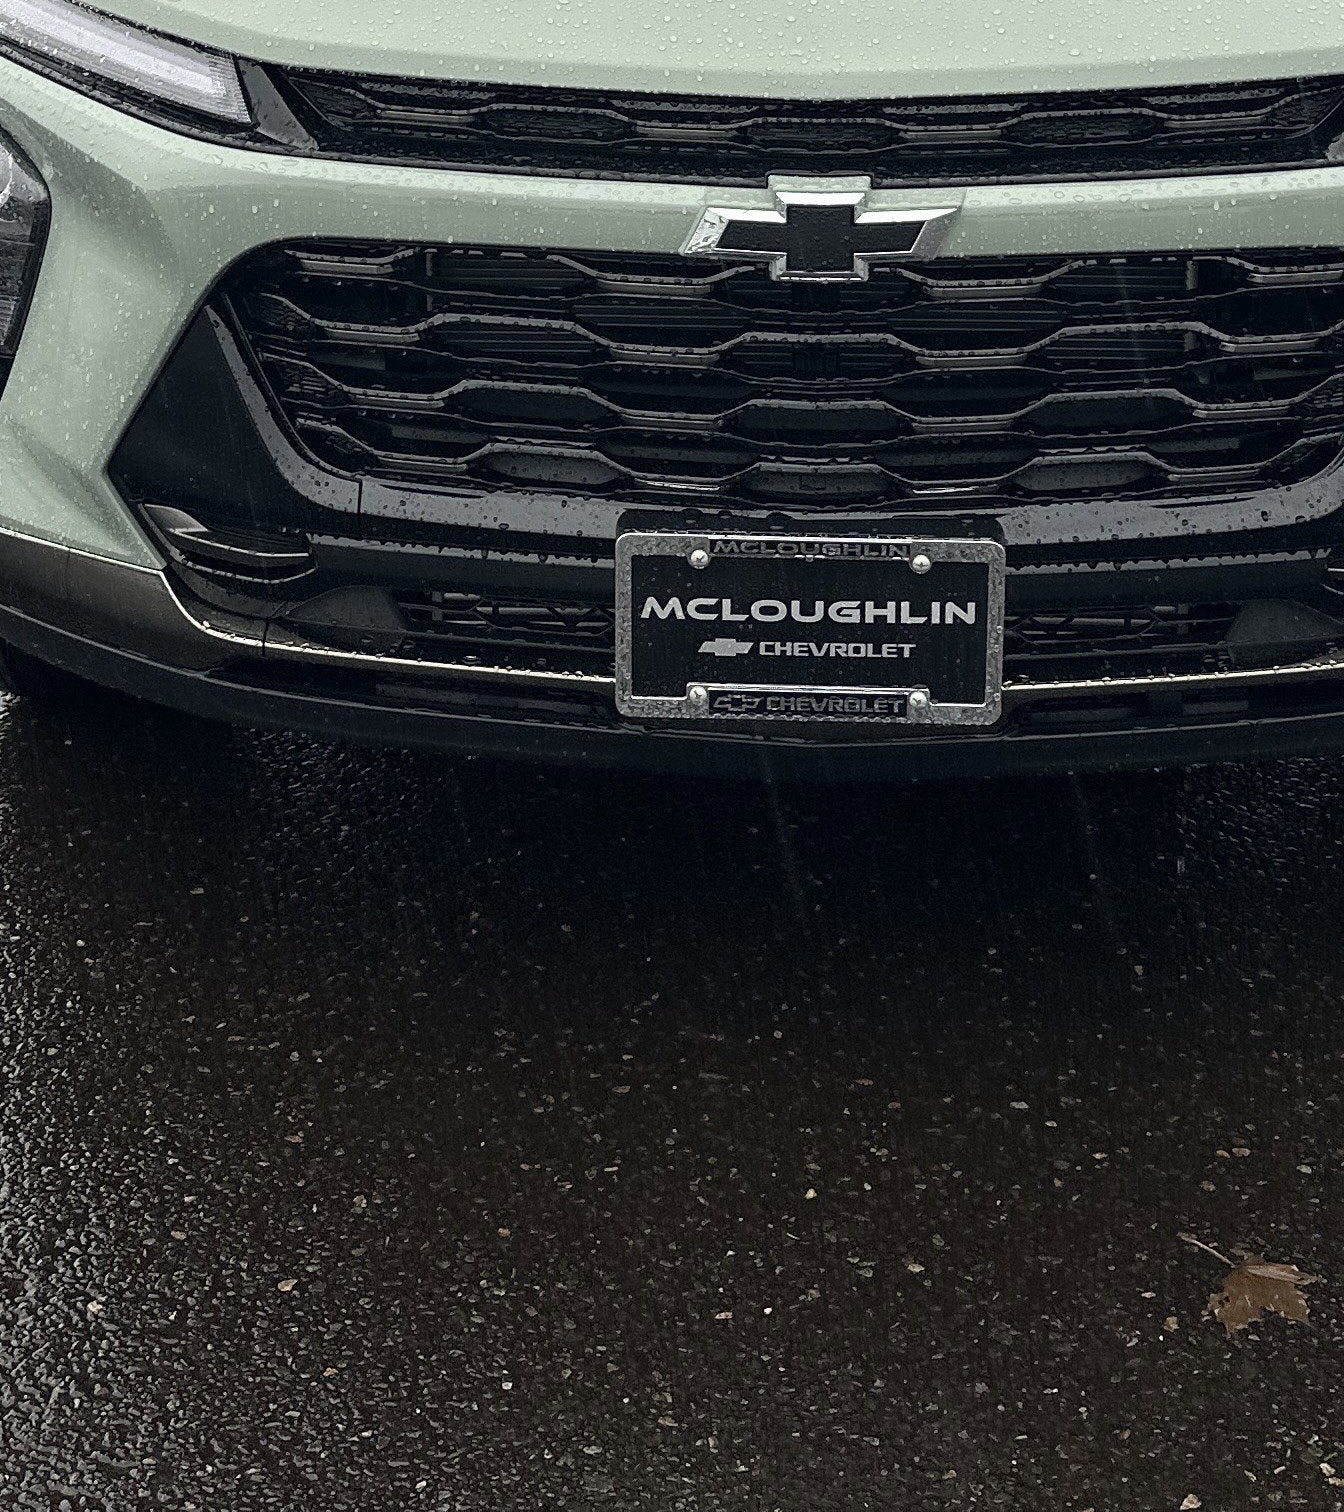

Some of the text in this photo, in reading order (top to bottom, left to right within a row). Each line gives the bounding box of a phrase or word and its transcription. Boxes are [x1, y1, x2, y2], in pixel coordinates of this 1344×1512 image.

[713, 540, 912, 557] MCLOUGHLIN
[640, 596, 976, 626] MCLOUGHLIN
[759, 640, 916, 659] CHEVROLET
[763, 695, 905, 714] CHEVROLET
